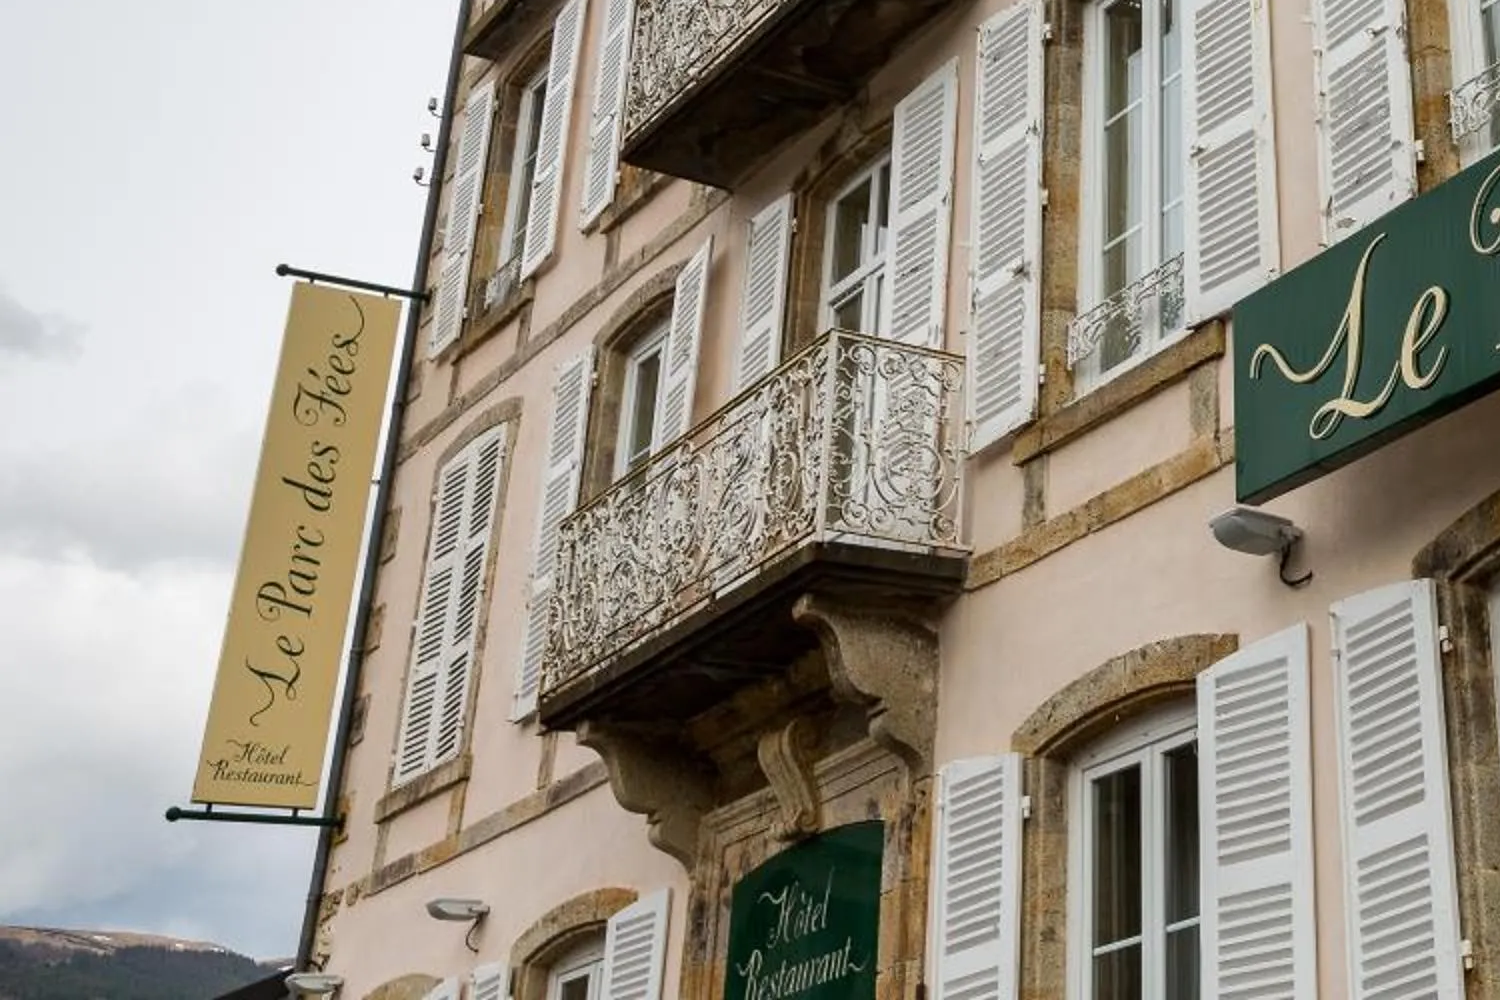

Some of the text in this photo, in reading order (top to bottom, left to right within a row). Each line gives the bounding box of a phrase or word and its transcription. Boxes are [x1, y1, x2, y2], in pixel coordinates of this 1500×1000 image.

[1249, 232, 1449, 441] Le
[246, 295, 366, 726] Le Parc des Fées
[206, 760, 320, 787] Restaurant
[225, 739, 291, 765] Hôtel
[757, 866, 837, 948] Hôtel
[736, 936, 872, 1000] Restaurant
